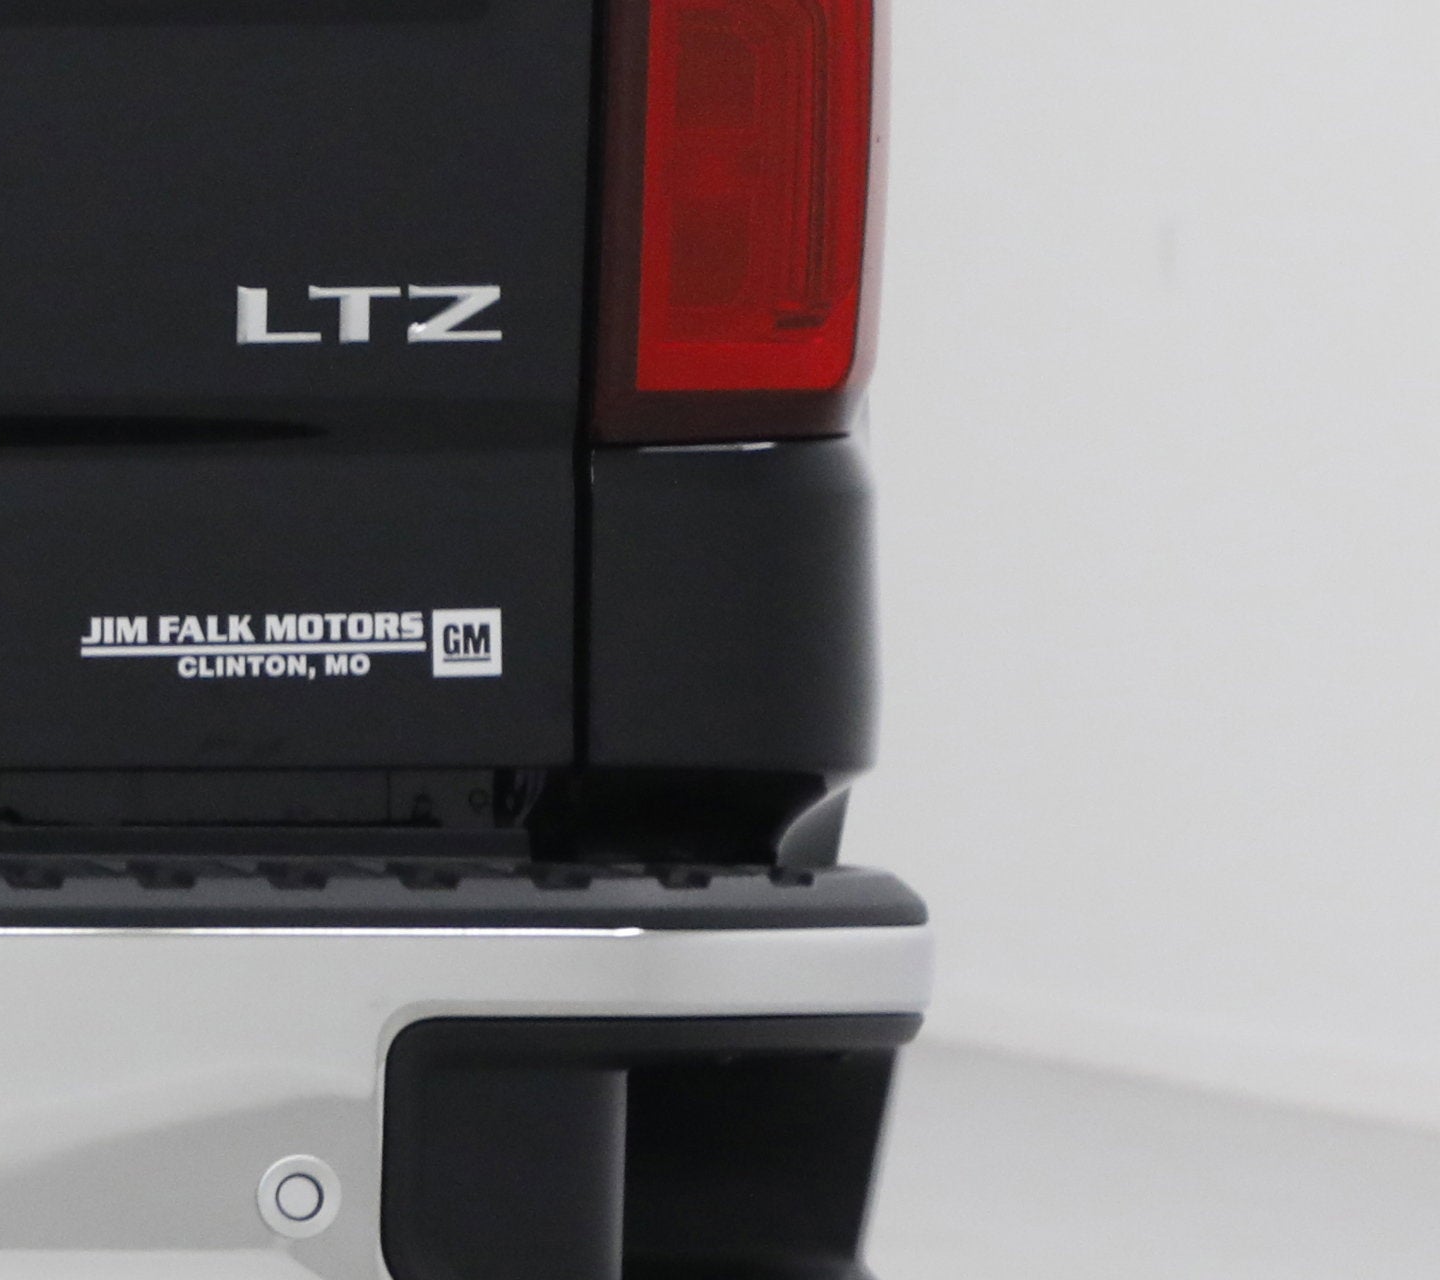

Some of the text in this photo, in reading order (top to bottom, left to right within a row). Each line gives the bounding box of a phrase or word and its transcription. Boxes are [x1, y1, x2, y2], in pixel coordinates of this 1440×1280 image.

[236, 284, 503, 345] LTZ
[81, 610, 424, 645] JIM FALK MOTORS
[442, 622, 492, 656] GM
[178, 652, 372, 680] CLINTON, MO
